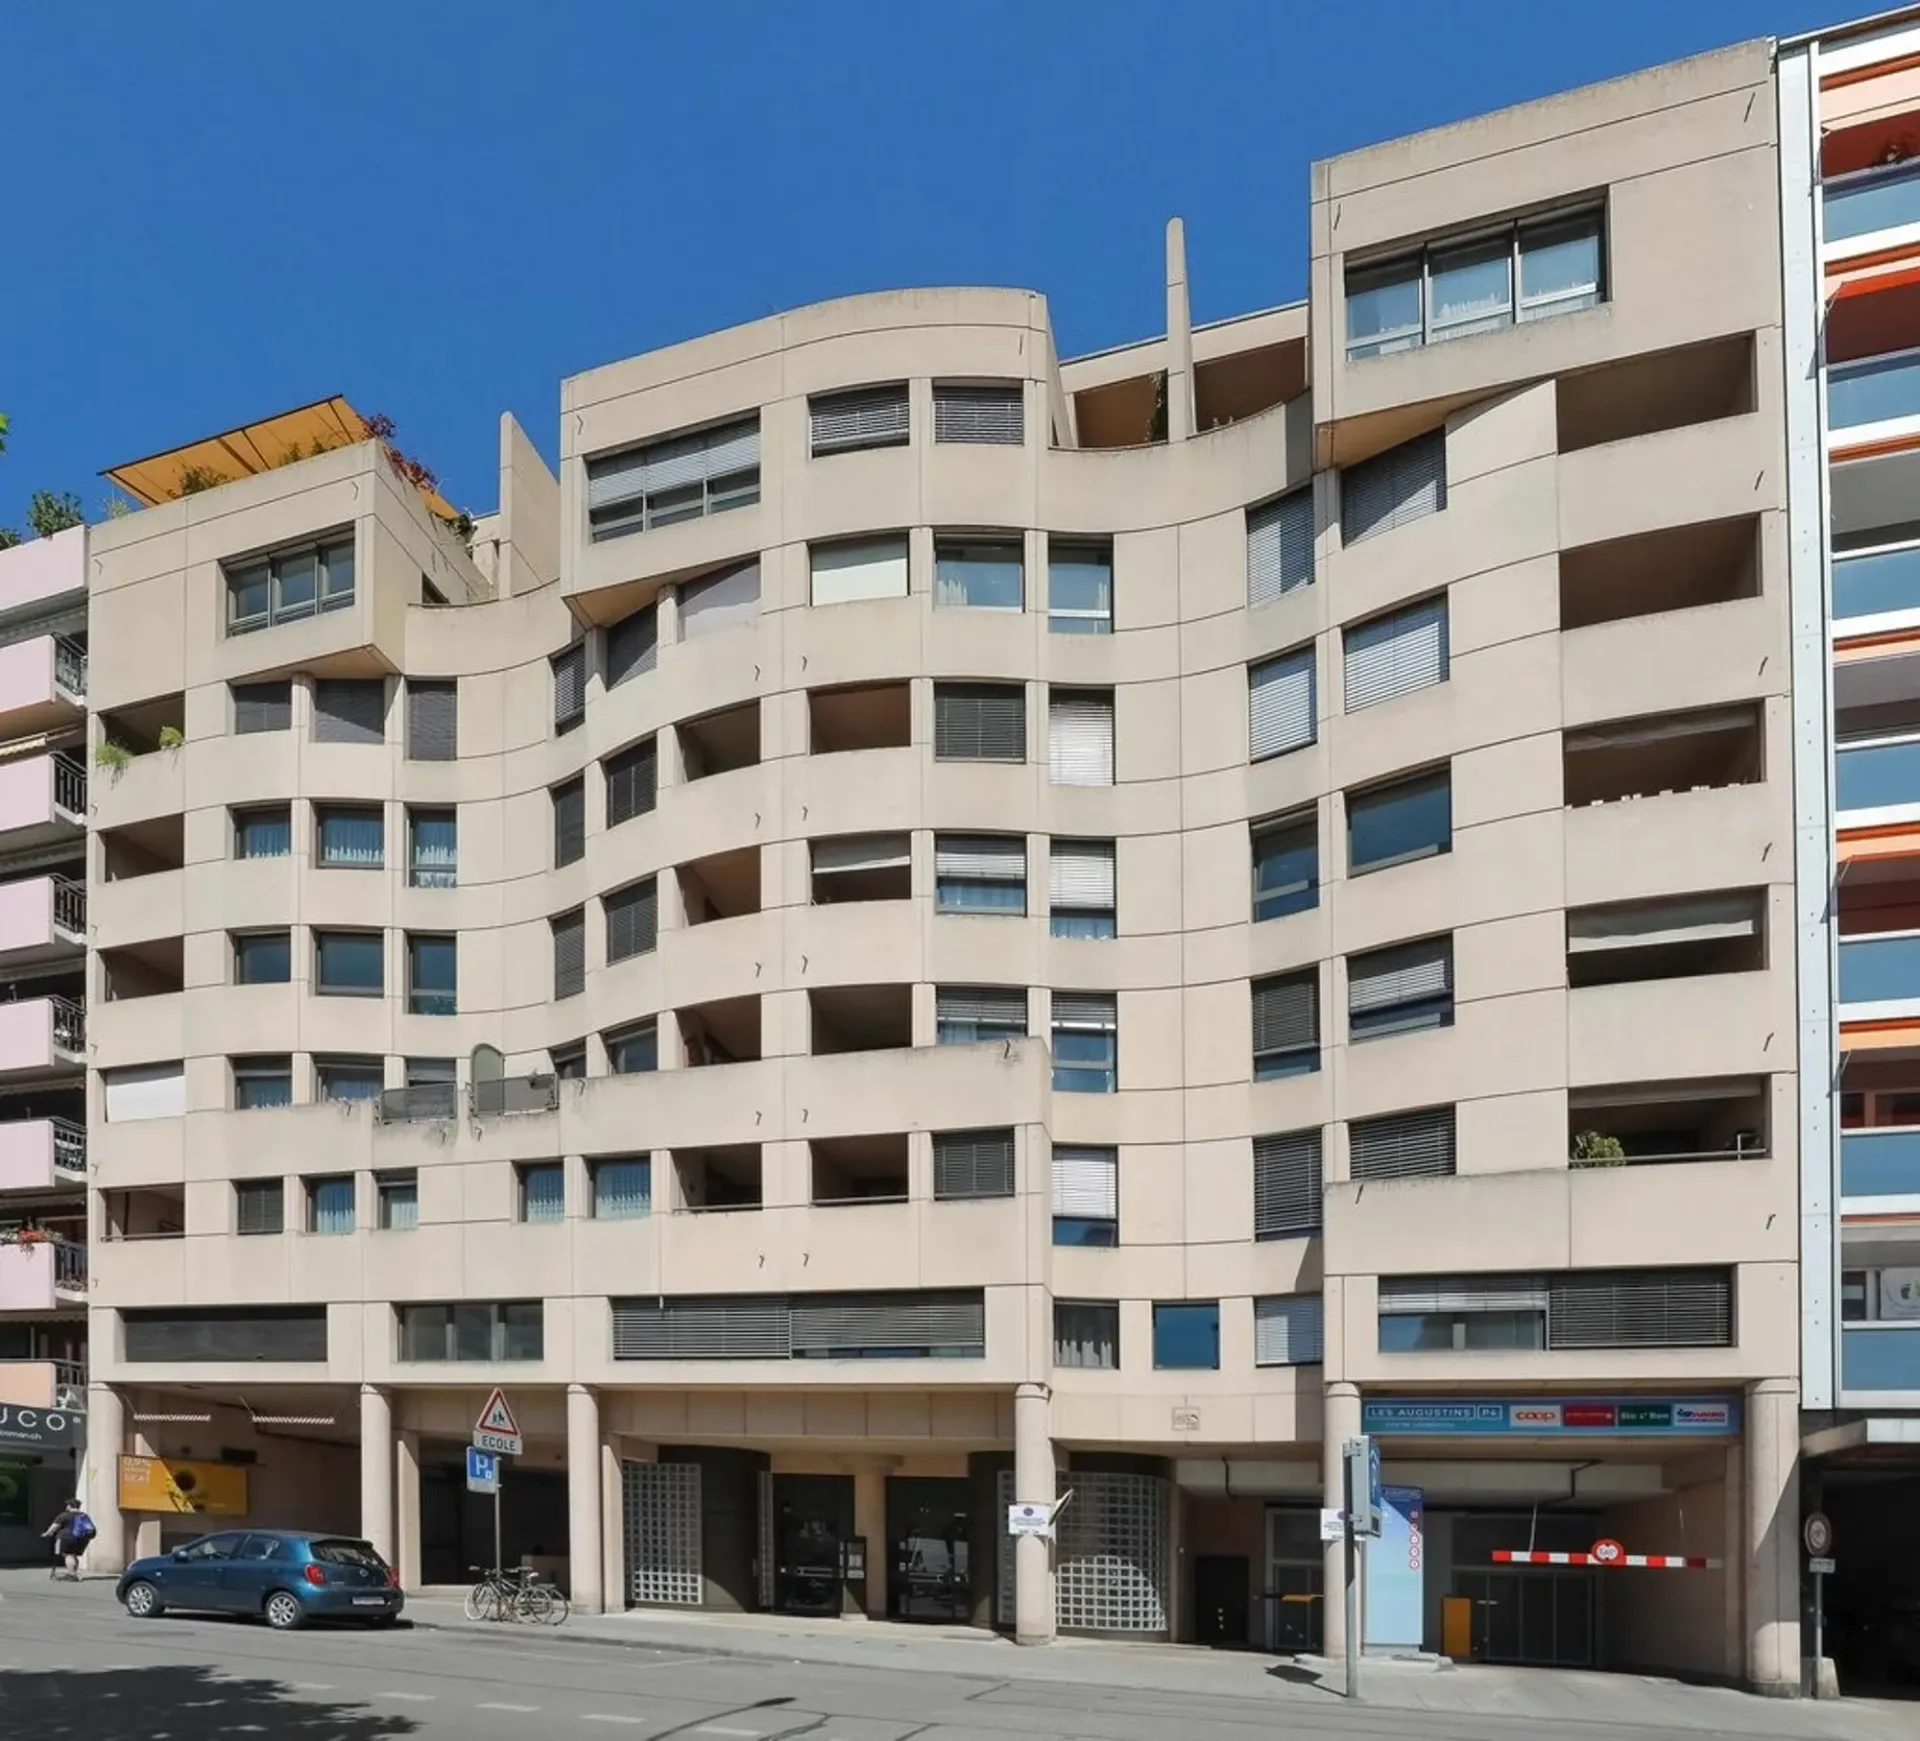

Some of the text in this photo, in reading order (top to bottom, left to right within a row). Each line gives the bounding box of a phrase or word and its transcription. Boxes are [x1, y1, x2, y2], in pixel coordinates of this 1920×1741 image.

[1370, 1407, 1472, 1418] LES AUGUSTINS
[1515, 1411, 1557, 1423] coop
[481, 1434, 516, 1452] ECOLE
[475, 1453, 489, 1476] P
